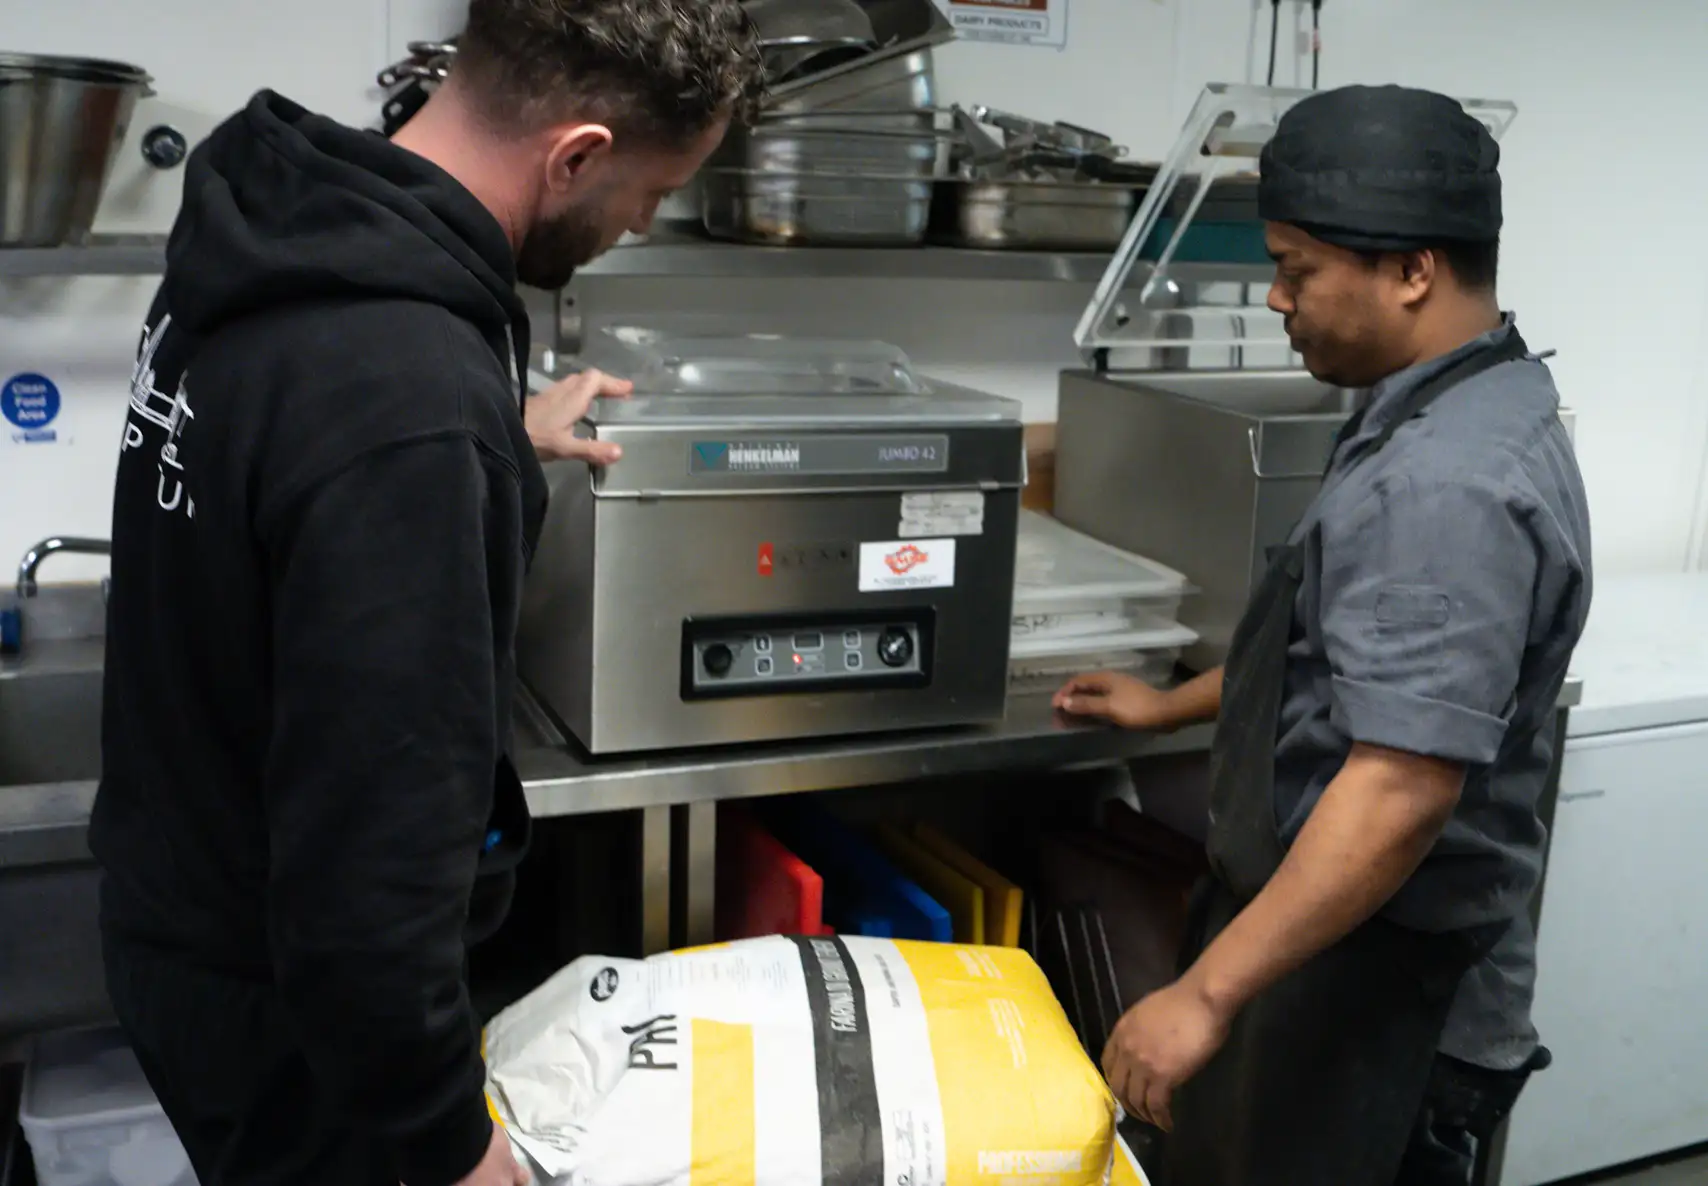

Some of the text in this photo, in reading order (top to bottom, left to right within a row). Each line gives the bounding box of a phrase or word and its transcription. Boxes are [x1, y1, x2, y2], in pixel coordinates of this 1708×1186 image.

[728, 449, 799, 463] HENKELMAN
[879, 445, 936, 461] JUMBO 42
